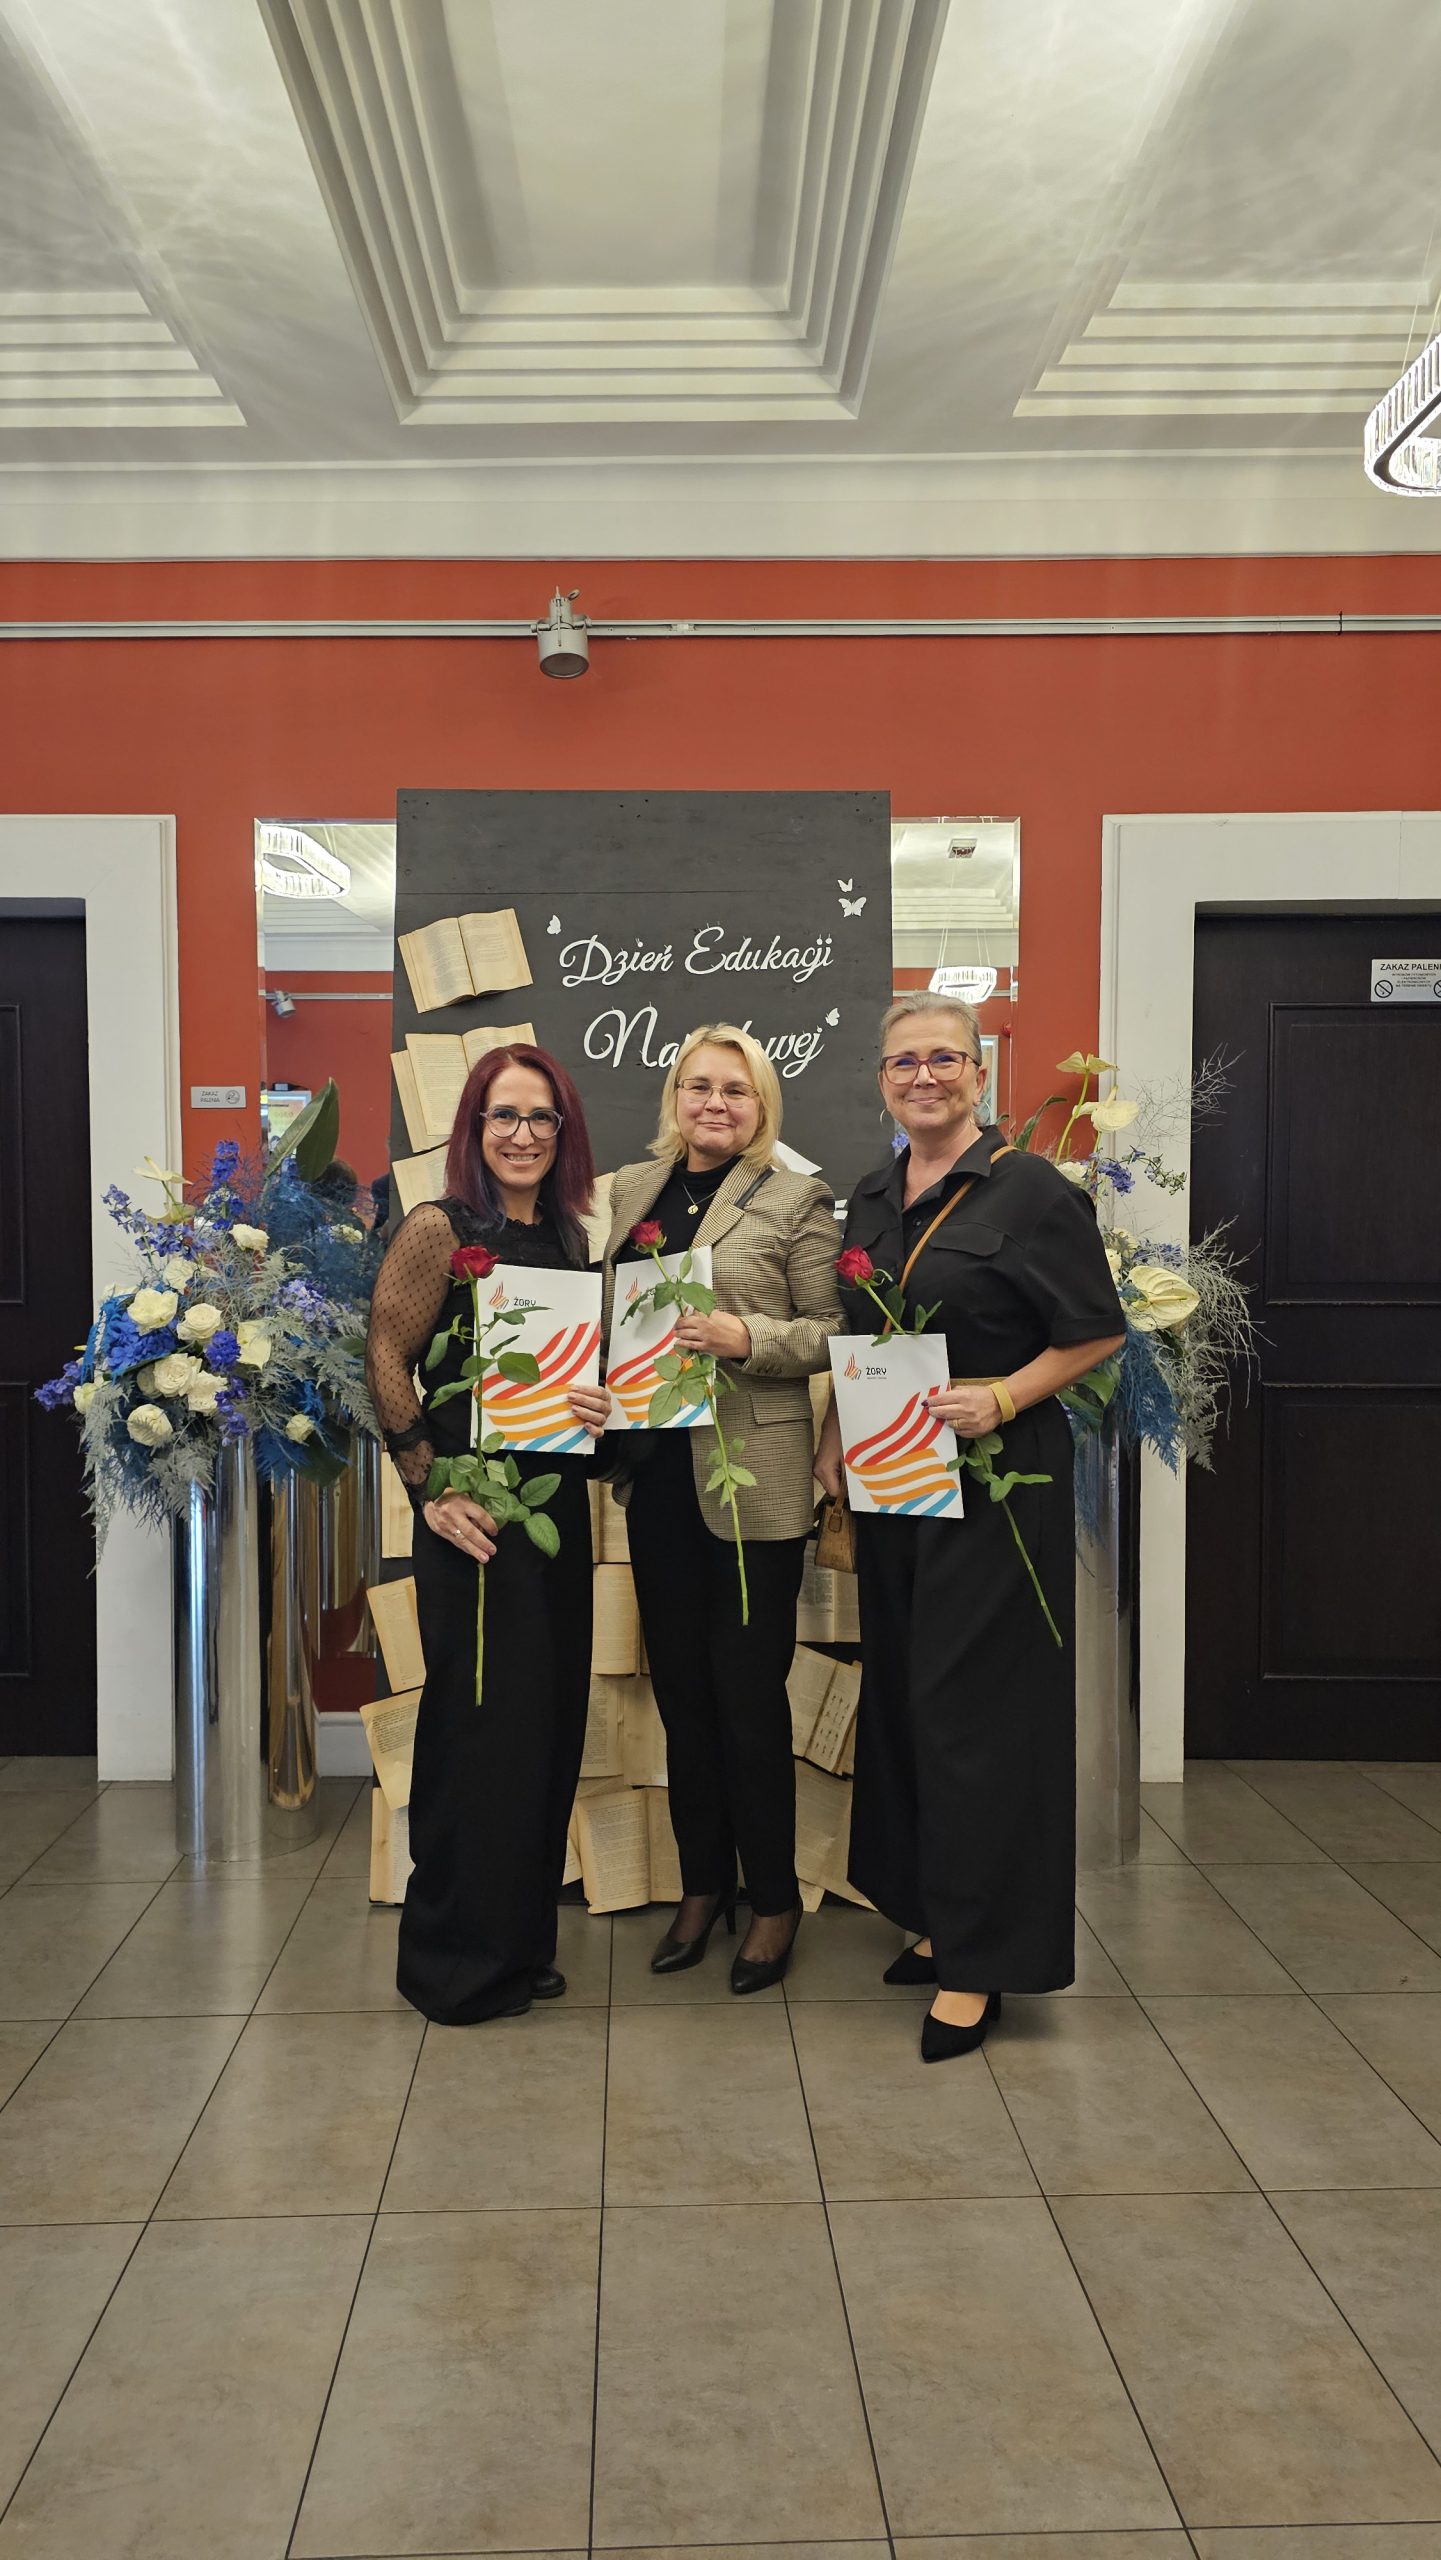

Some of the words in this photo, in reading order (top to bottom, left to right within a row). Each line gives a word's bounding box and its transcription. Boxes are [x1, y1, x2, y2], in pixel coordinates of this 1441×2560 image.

[559, 934, 674, 987] Dzień
[684, 926, 834, 983] Edukacji
[1380, 963, 1409, 971] ZAKAZ
[583, 1005, 825, 1079] Nawej
[866, 1365, 887, 1376] ŻORY
